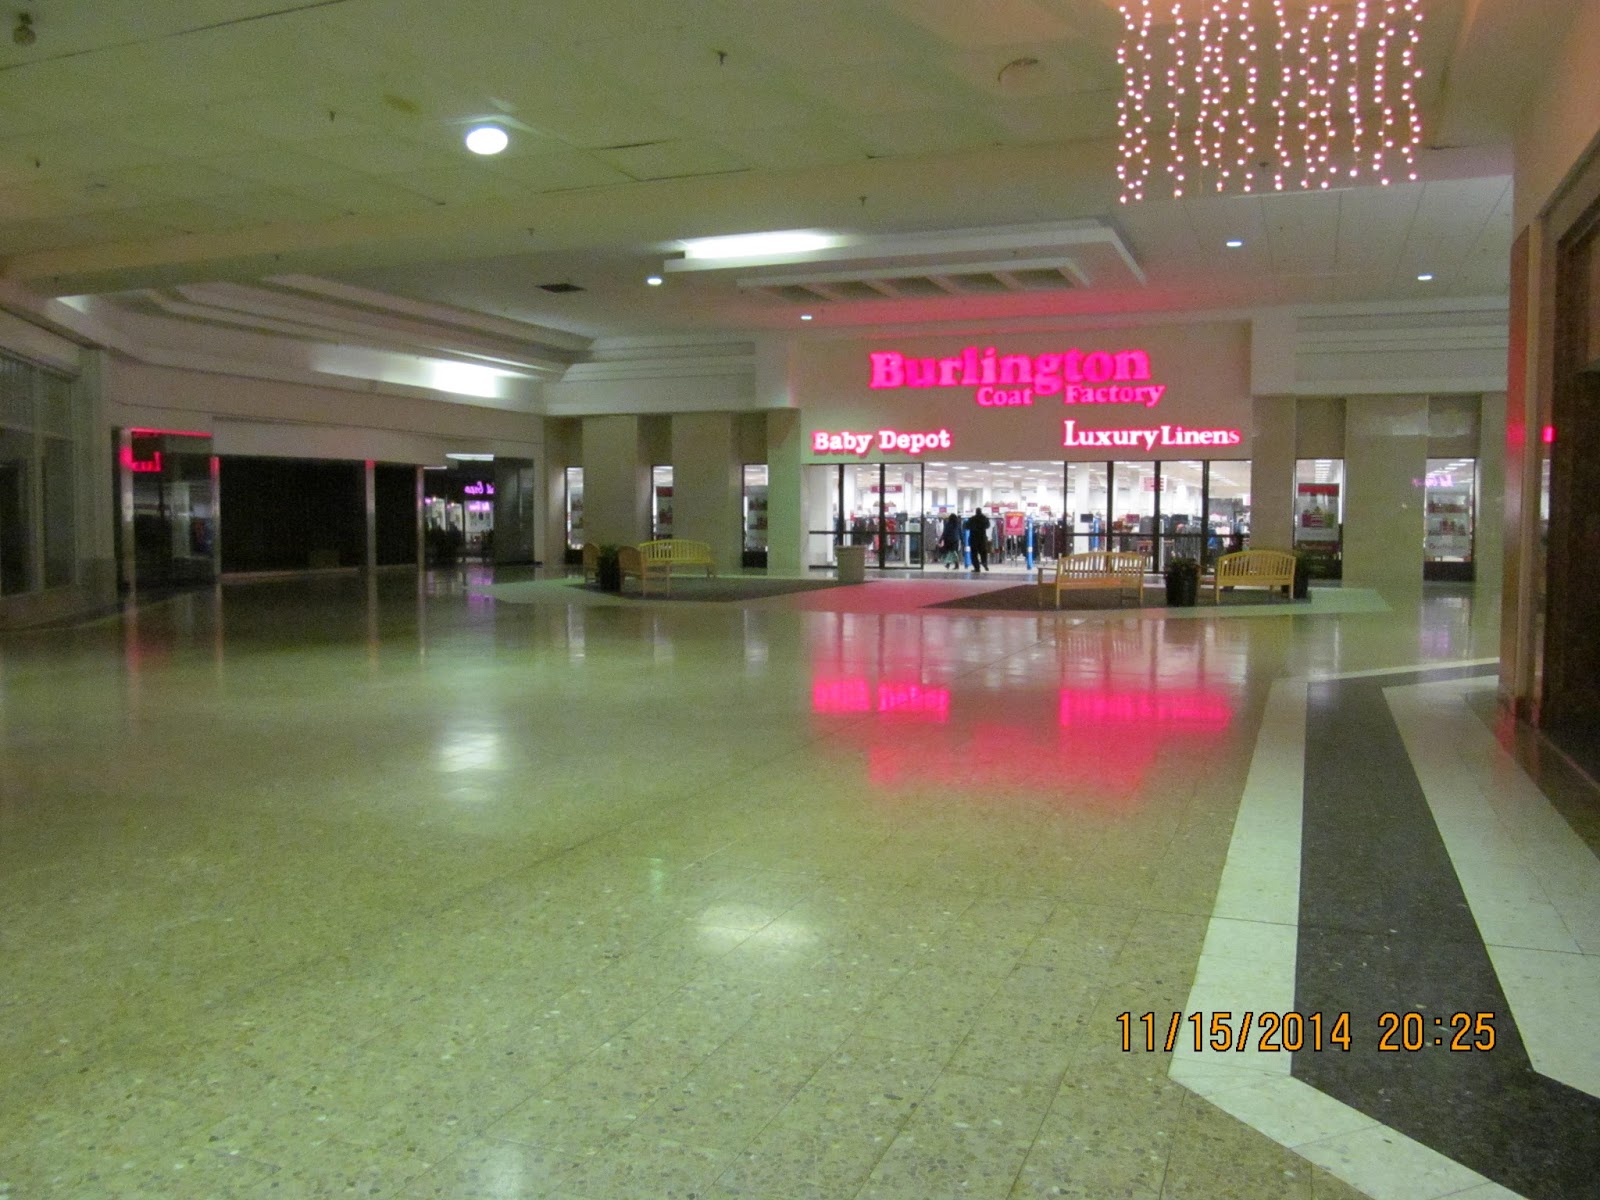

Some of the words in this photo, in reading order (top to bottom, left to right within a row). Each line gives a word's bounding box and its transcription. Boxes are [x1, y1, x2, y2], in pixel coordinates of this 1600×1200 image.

[870, 348, 1151, 393] Burlington
[976, 386, 1033, 406] Coat
[1064, 384, 1166, 407] Factory
[813, 431, 872, 454] Baby
[879, 429, 951, 453] Depot
[1063, 420, 1158, 450] Luxury
[1161, 425, 1241, 446] Linens
